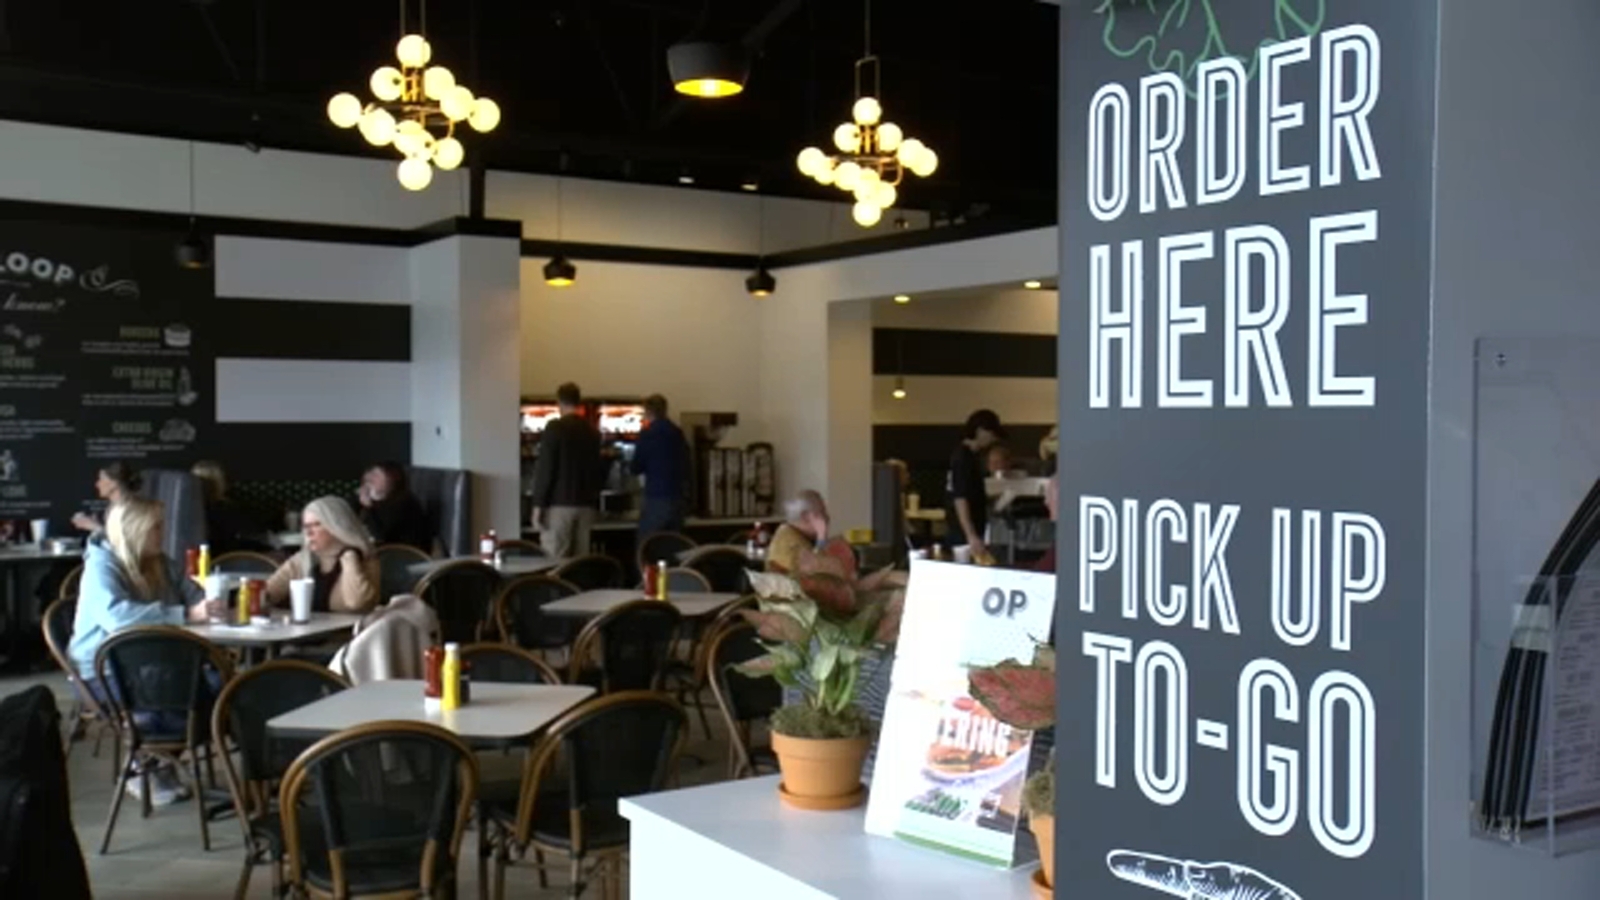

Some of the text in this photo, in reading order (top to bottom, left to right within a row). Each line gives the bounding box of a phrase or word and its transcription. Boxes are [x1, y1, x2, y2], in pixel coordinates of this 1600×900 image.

[1088, 24, 1381, 221] ORDER
[1089, 210, 1377, 408] HERE
[1080, 495, 1386, 651] PICK UP
[1083, 631, 1375, 858] TO-GO
